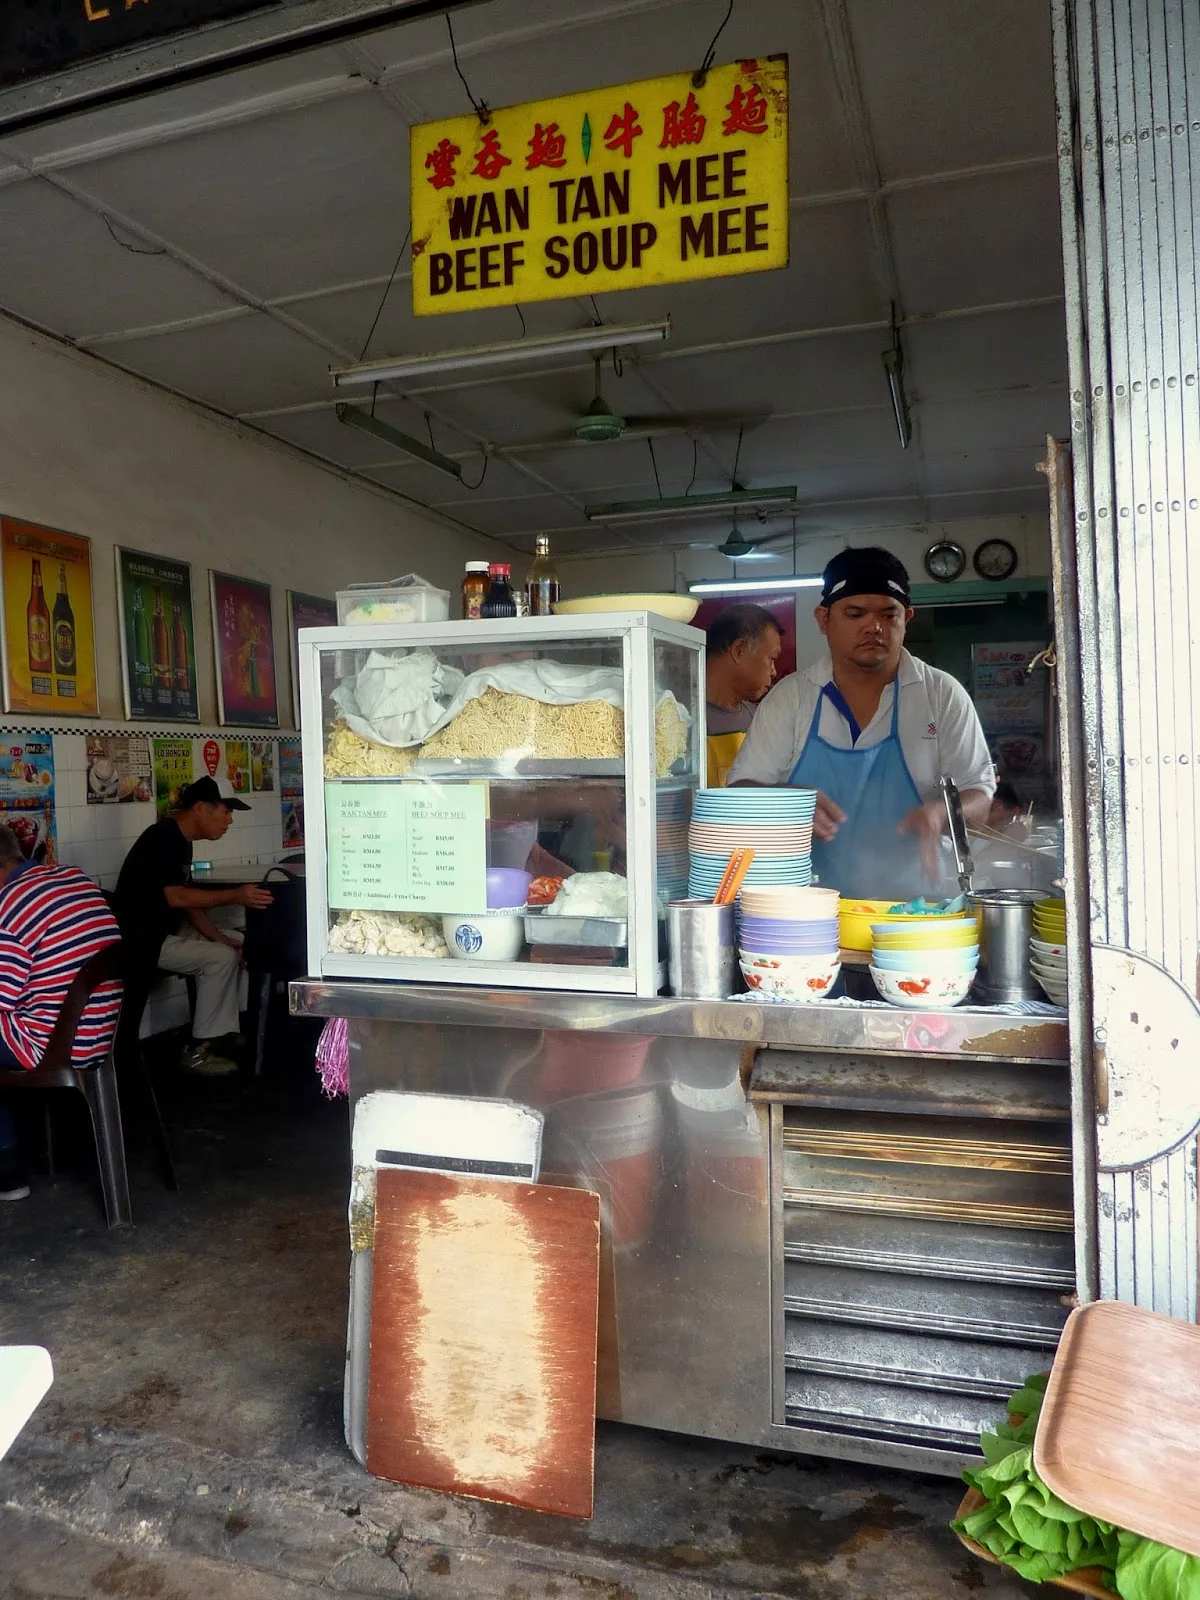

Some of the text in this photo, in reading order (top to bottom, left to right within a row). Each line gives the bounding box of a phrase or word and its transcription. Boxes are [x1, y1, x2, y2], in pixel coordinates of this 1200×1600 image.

[448, 149, 747, 241] WAN TAN MEE
[429, 203, 769, 296] BEEF SOUP MEE
